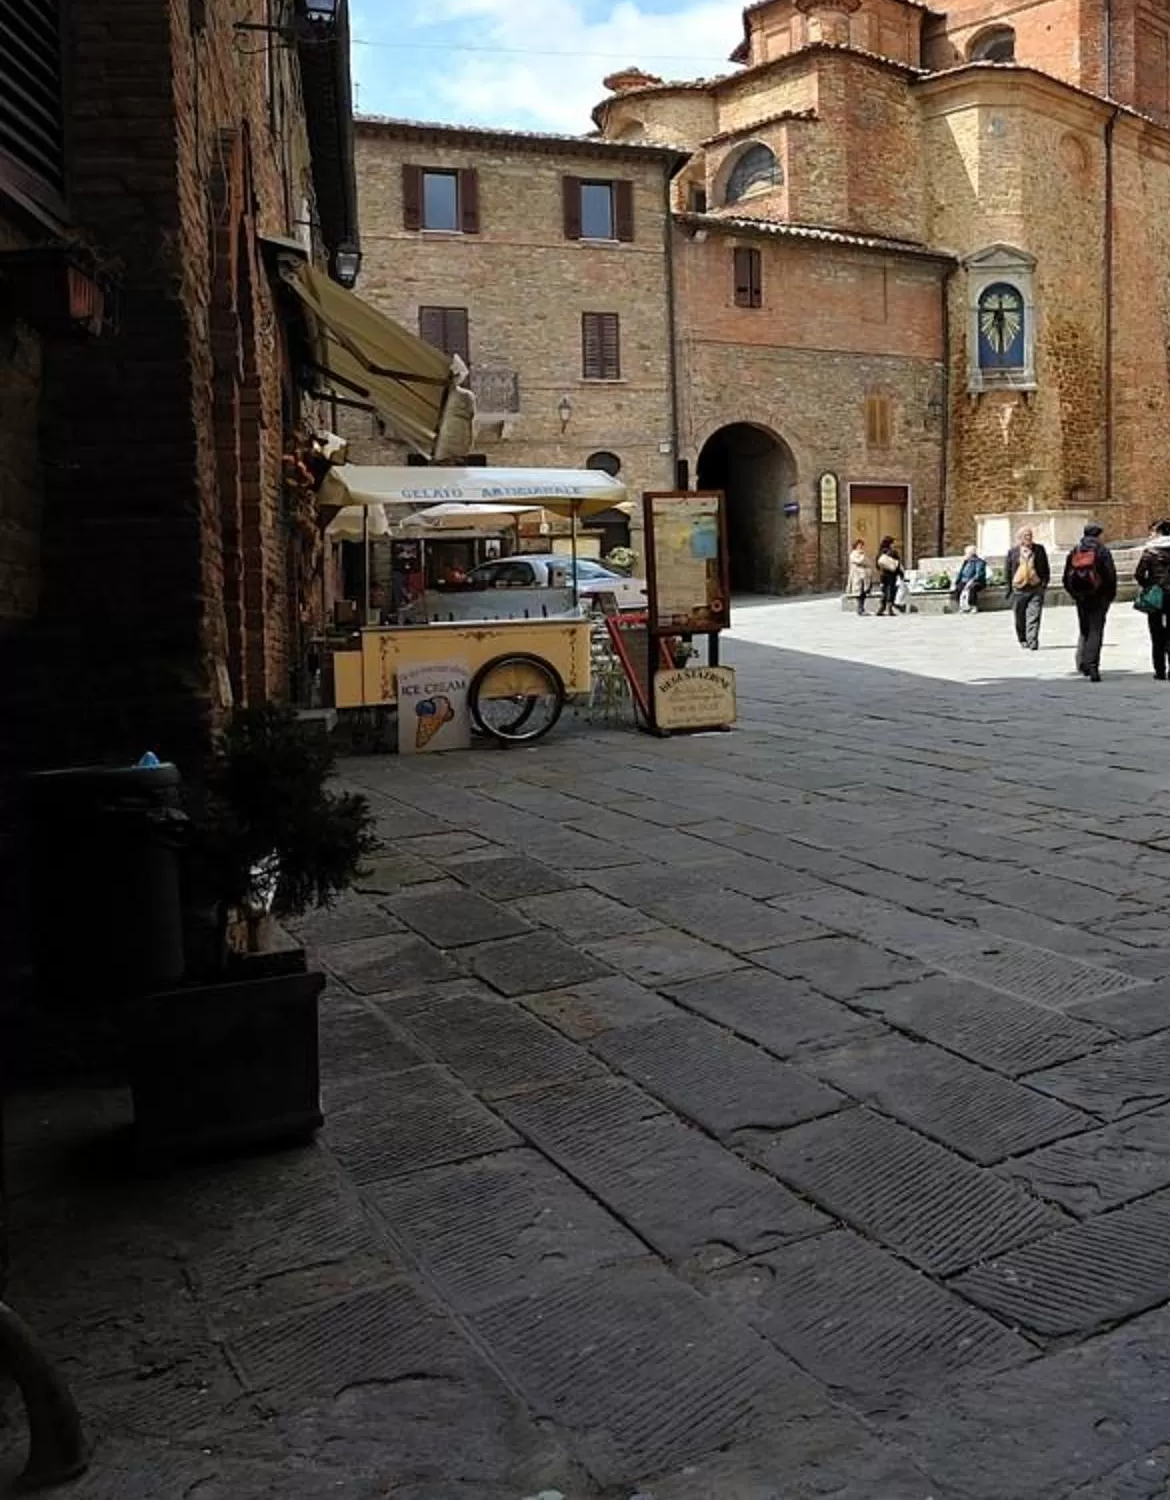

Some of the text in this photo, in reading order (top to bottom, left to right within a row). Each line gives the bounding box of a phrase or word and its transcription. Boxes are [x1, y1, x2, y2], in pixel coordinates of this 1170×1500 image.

[401, 485, 581, 498] GELATO ARTIGIANALE
[401, 680, 466, 696] ICE CREAM
